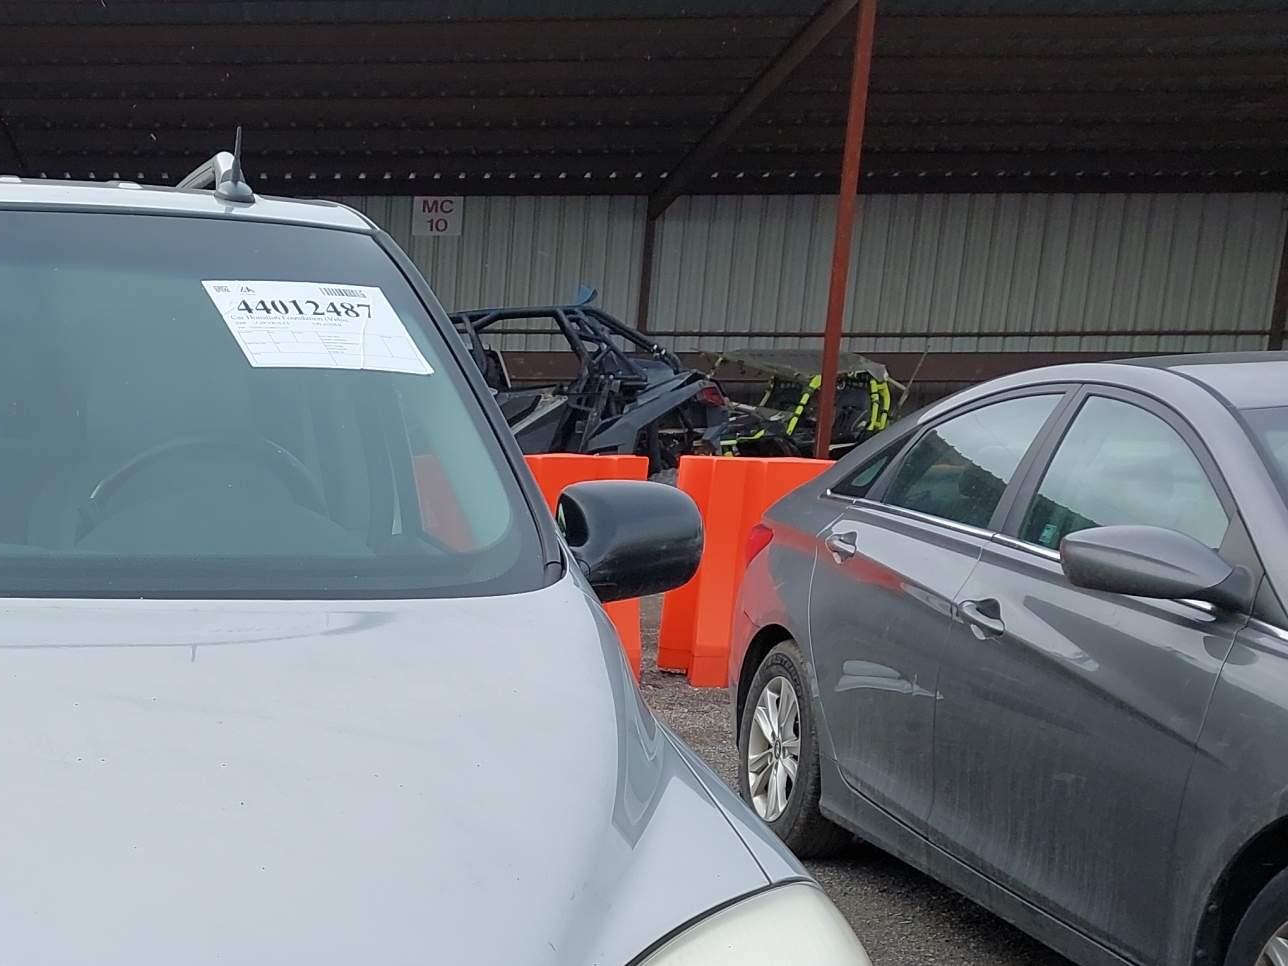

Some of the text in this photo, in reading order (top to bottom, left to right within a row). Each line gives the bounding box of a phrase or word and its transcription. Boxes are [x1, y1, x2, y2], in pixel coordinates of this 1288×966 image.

[422, 199, 455, 214] MC
[426, 218, 449, 233] 10
[237, 299, 372, 319] 44012487
